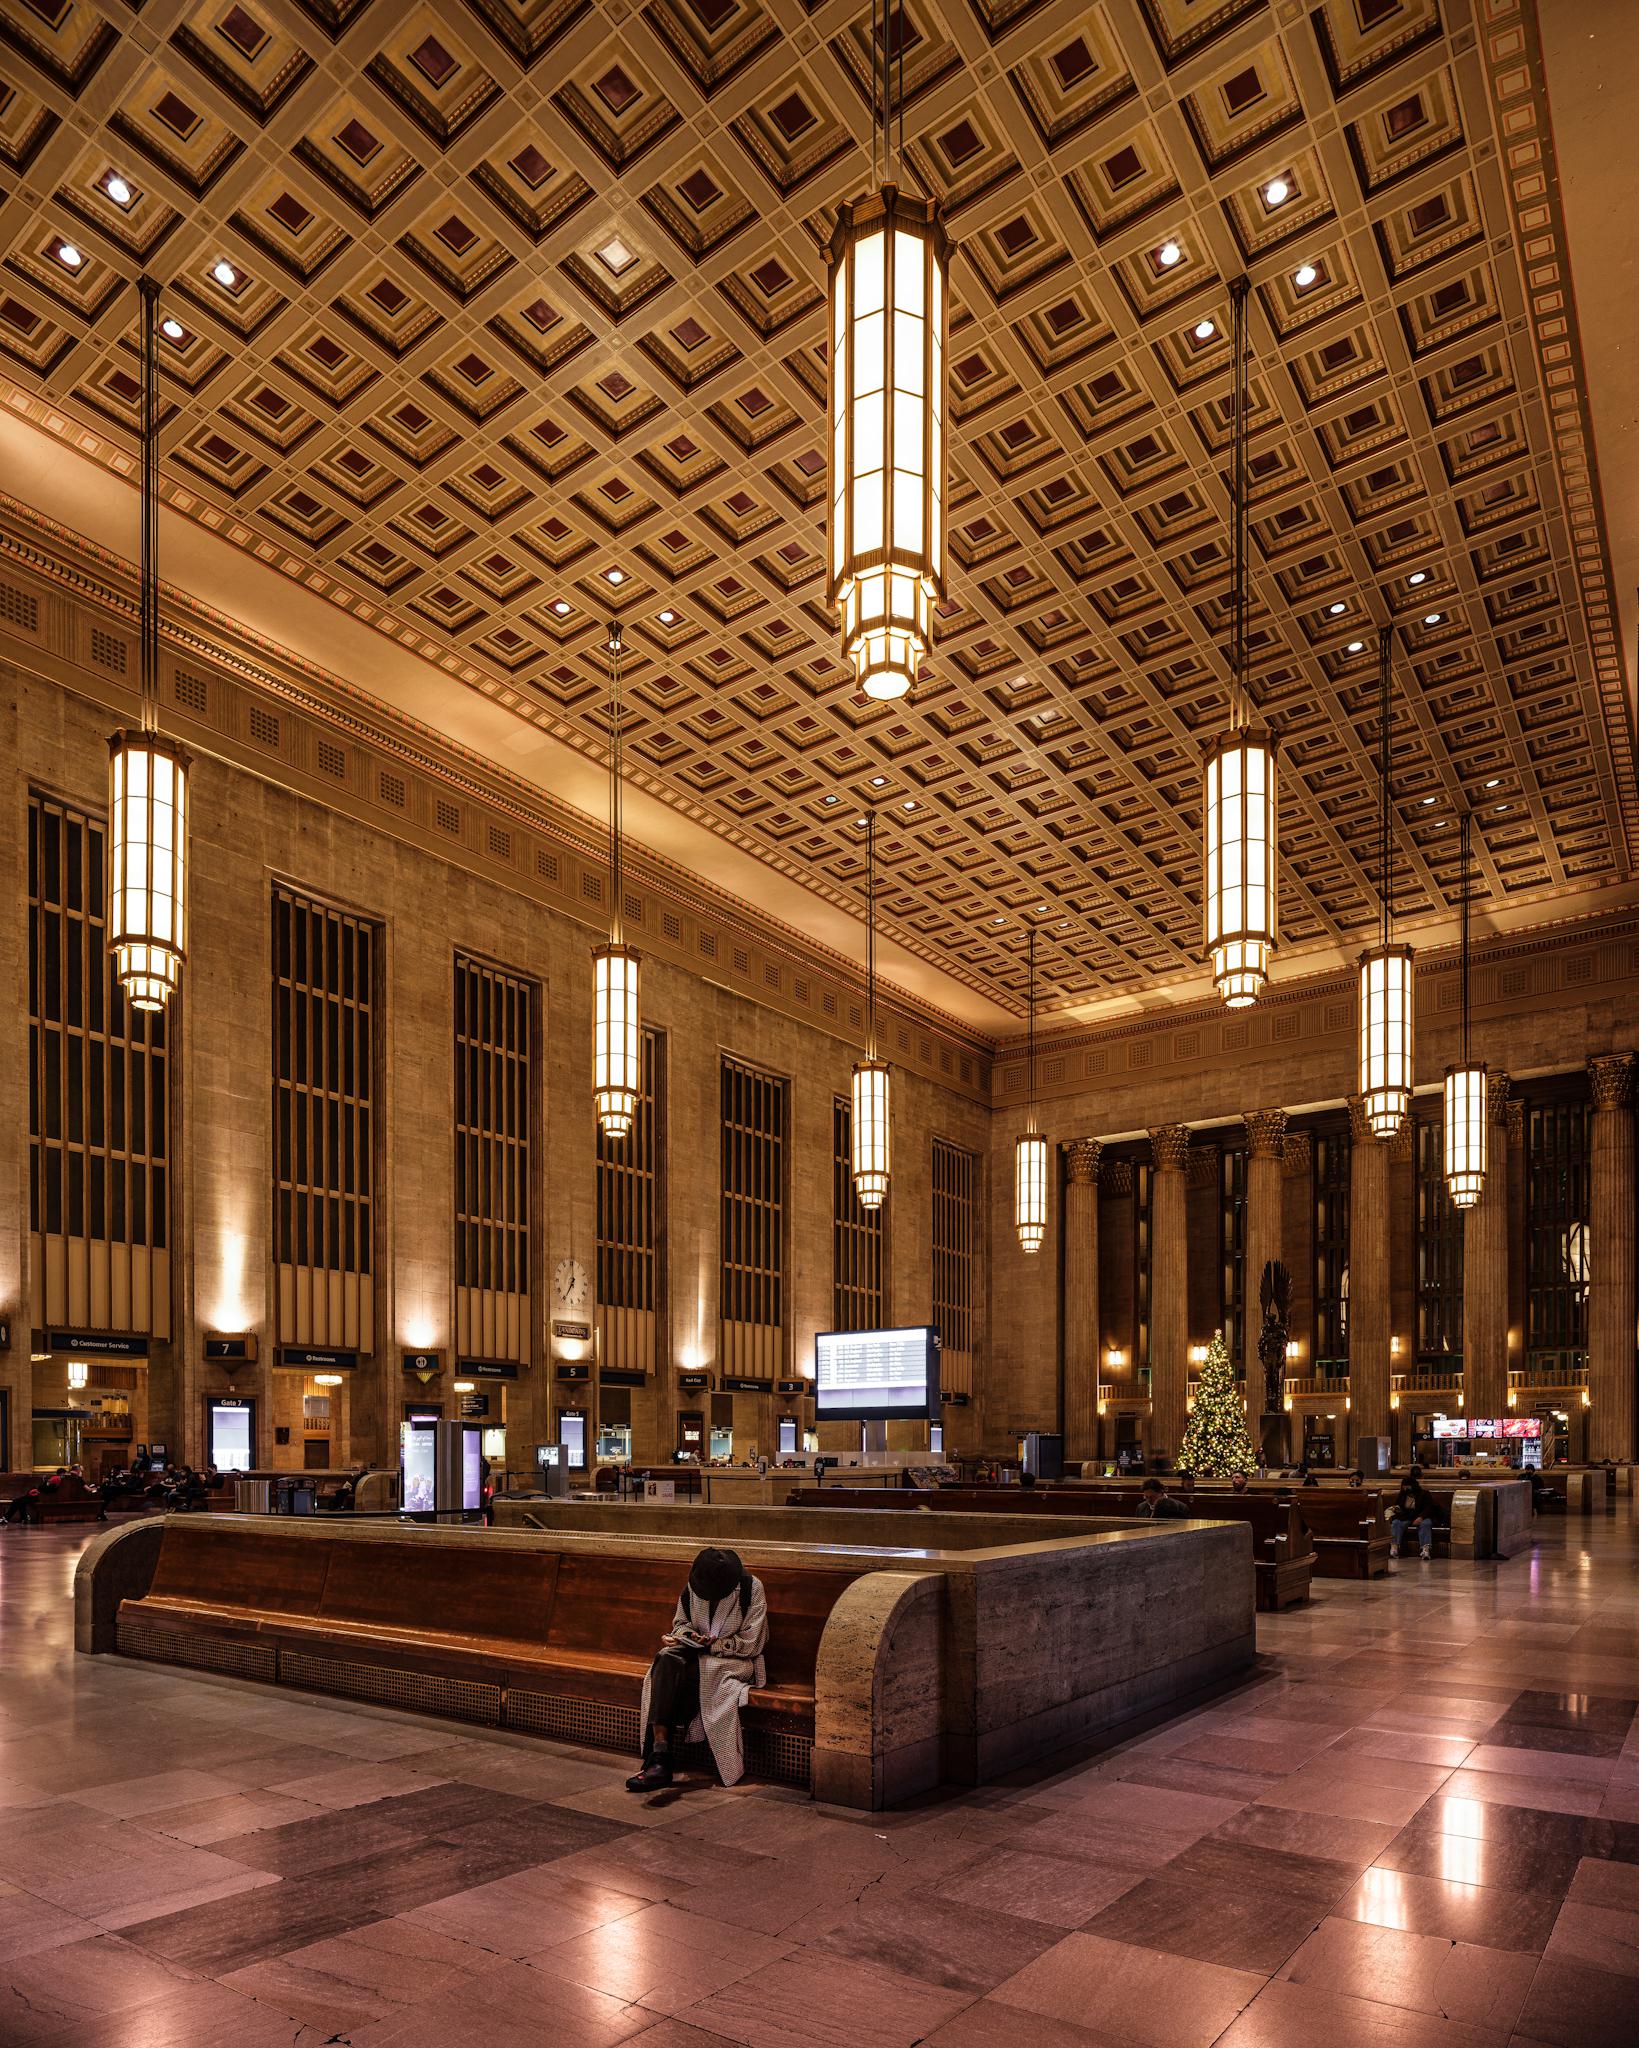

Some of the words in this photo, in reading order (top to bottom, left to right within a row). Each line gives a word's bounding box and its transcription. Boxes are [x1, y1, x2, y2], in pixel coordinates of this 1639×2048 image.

[79, 1340, 108, 1348] Customer
[109, 1341, 130, 1350] Service
[222, 1343, 230, 1354] 7
[569, 1367, 576, 1377] 5
[788, 1383, 794, 1391] 3
